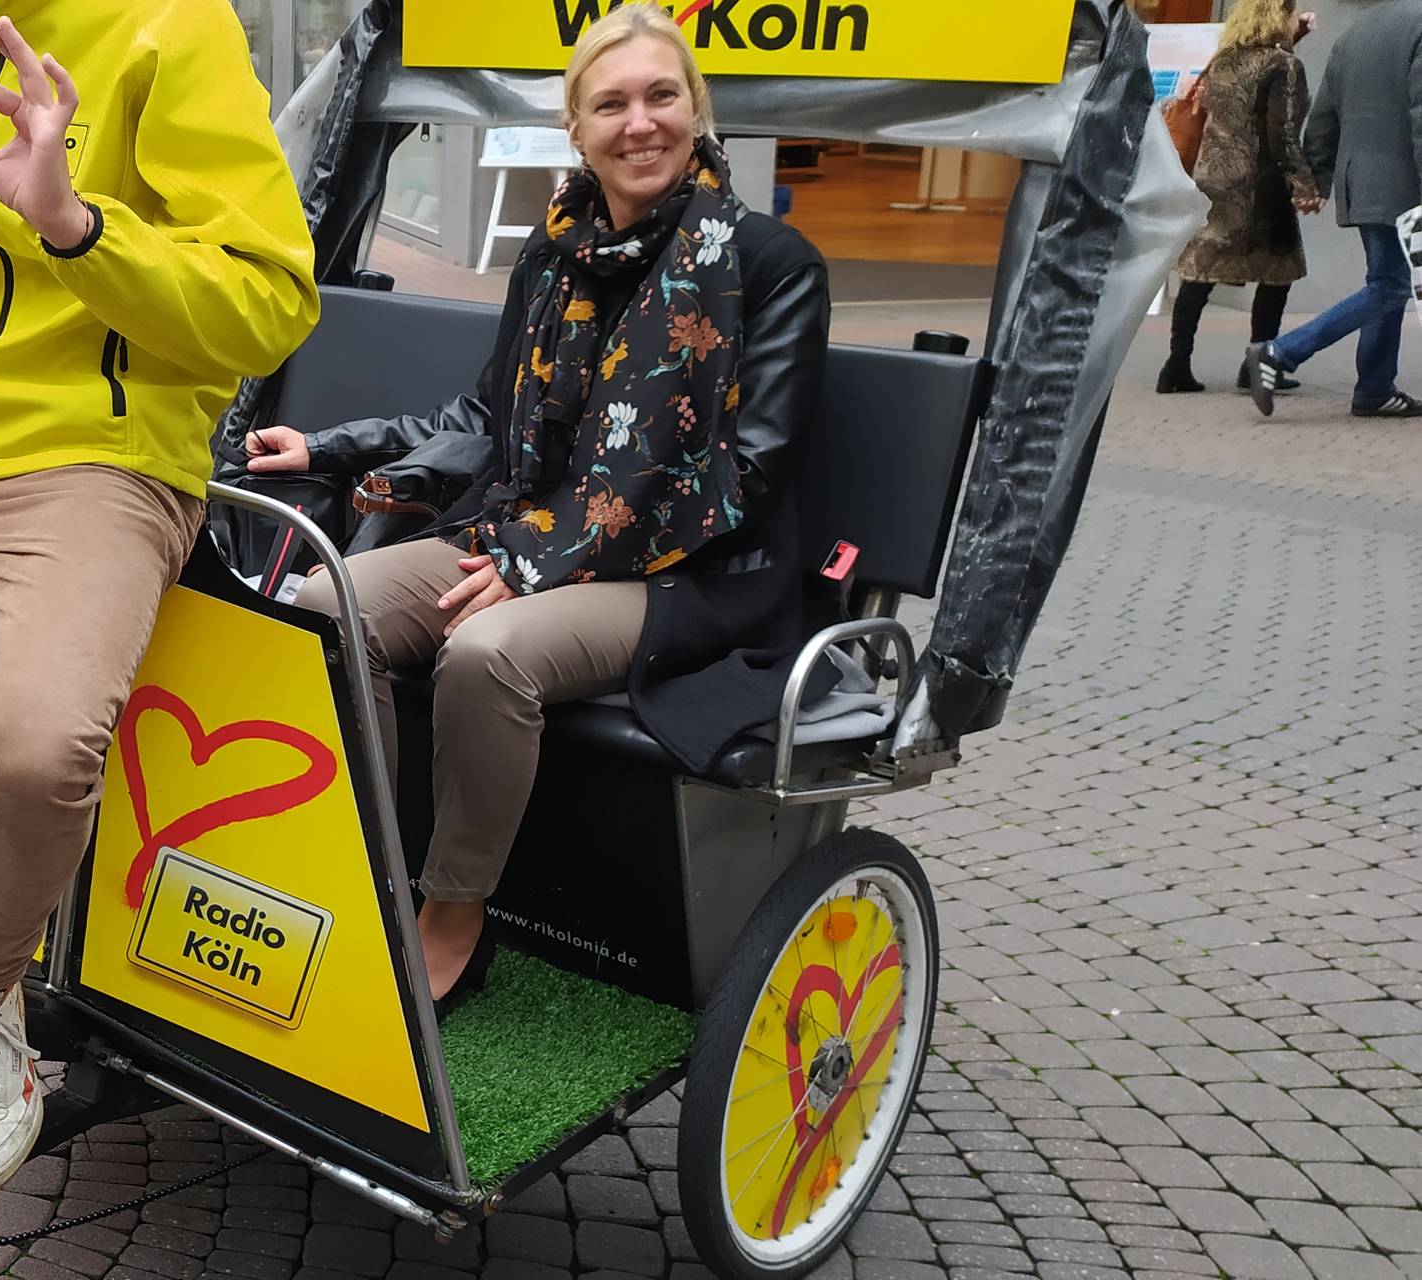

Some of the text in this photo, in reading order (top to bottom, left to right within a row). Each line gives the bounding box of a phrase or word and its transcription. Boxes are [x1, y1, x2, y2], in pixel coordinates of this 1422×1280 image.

[183, 885, 286, 949] Radio
[485, 904, 638, 968] www.rikolonia.de
[182, 930, 262, 987] Köln
